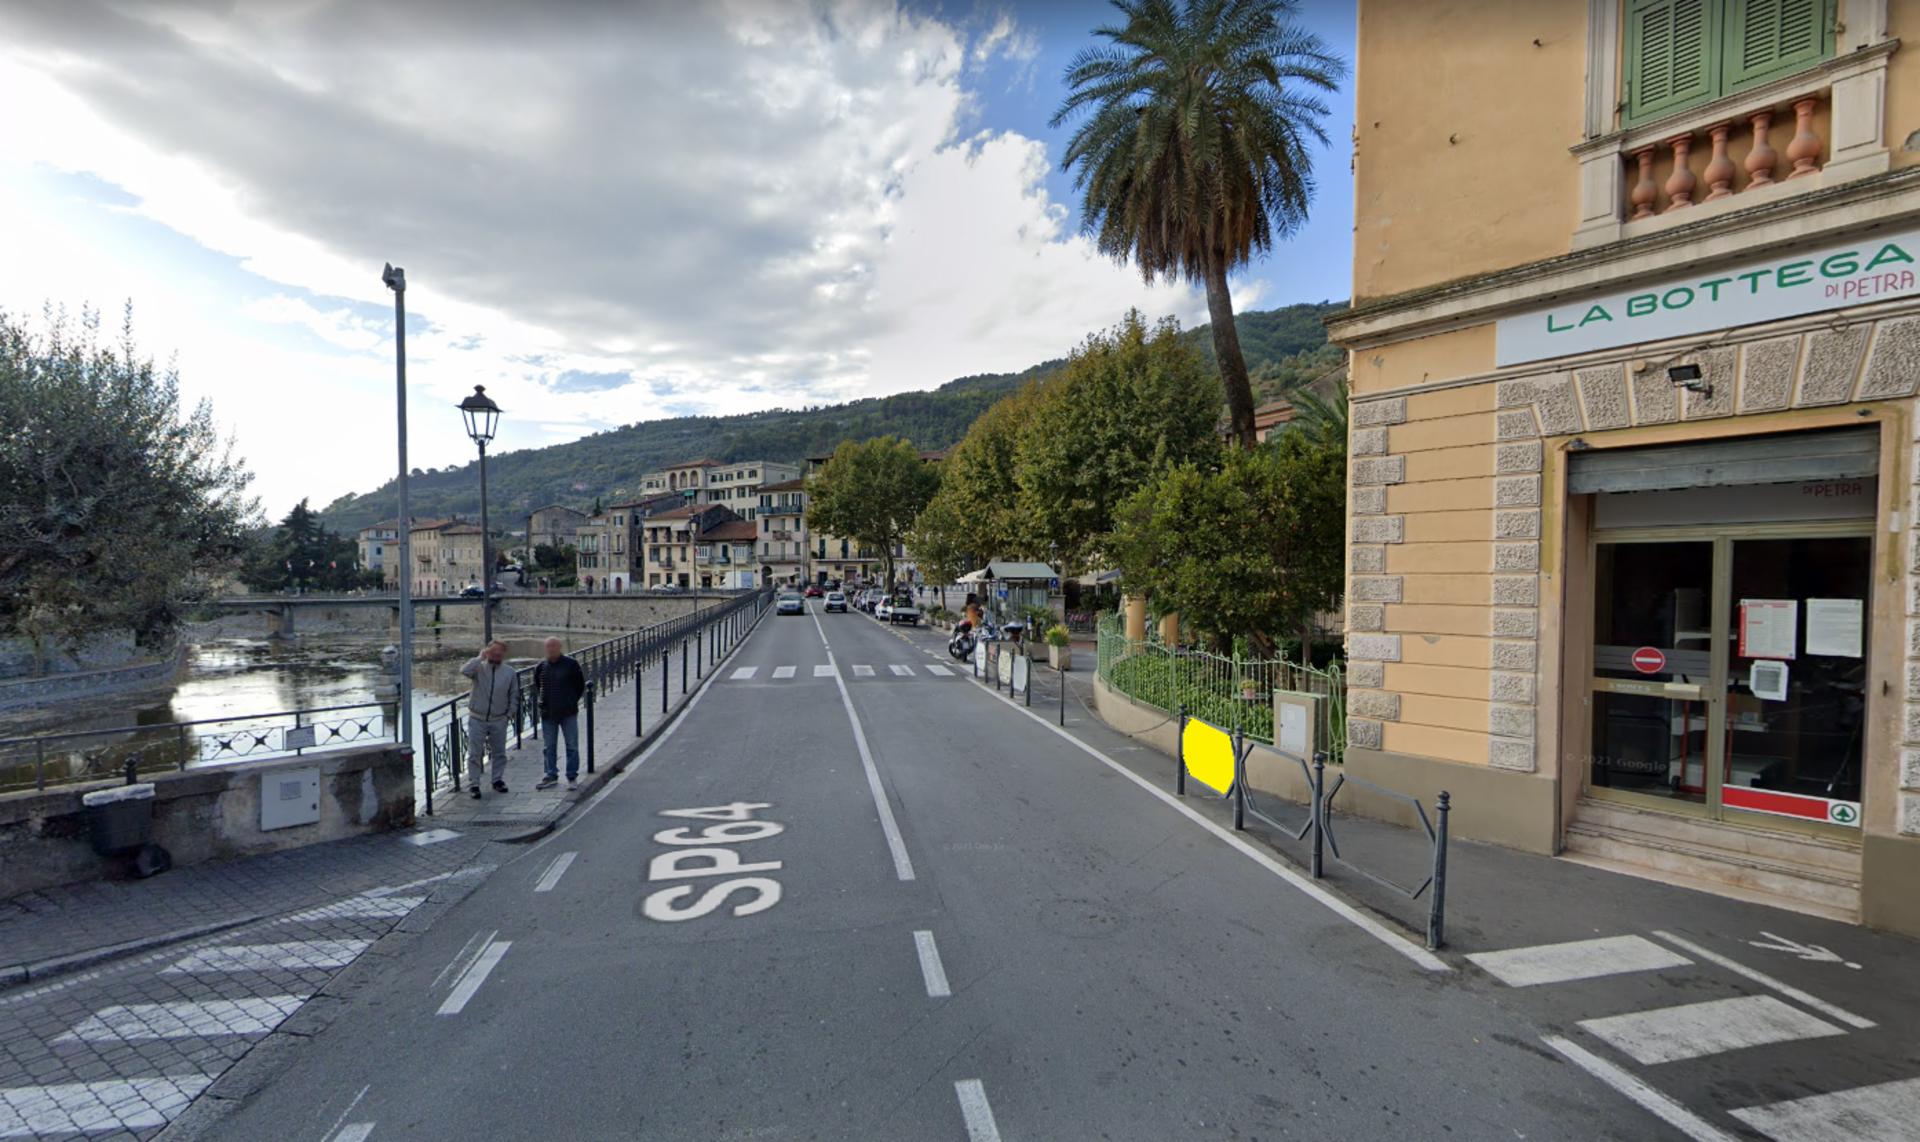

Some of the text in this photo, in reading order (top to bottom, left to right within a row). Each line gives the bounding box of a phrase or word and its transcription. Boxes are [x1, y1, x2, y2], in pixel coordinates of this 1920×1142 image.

[1547, 243, 1915, 333] LA BOTTEGA
[1825, 270, 1915, 300] DI PETRA
[1815, 482, 1862, 497] PETRA
[643, 801, 784, 922] SP64
